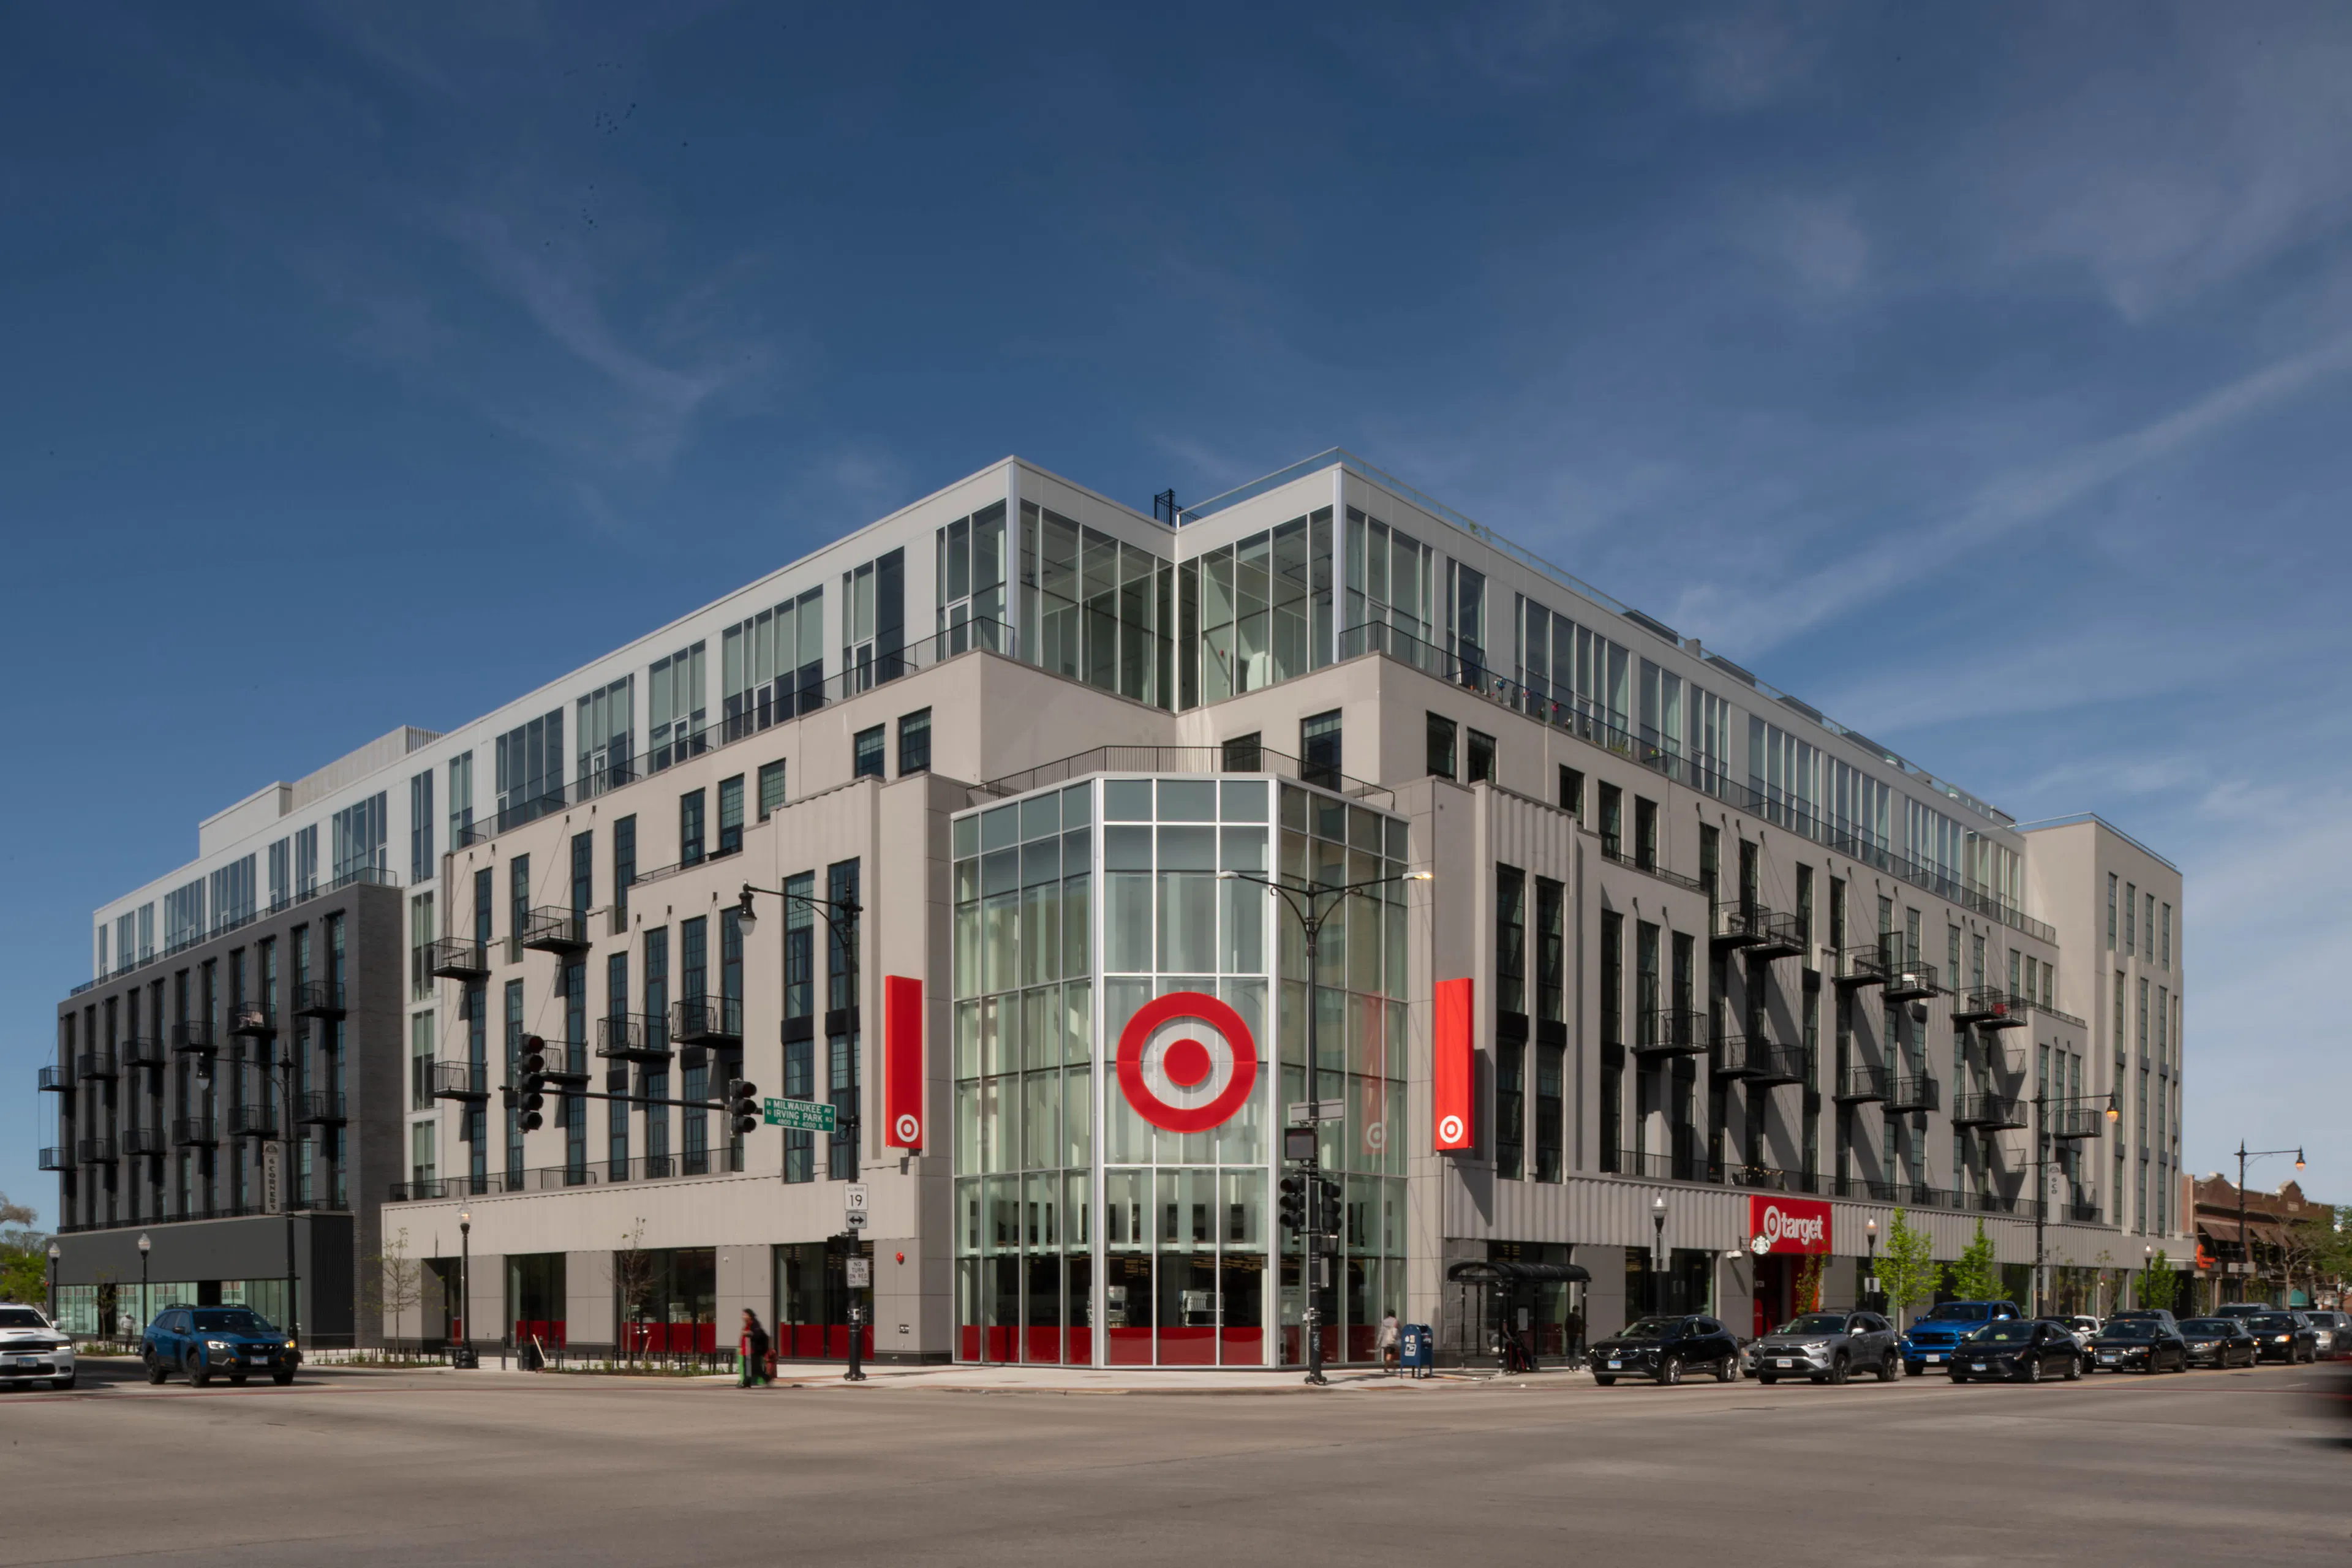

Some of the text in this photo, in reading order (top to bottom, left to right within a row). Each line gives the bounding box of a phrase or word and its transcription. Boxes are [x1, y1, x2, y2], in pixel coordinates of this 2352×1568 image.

[774, 1100, 821, 1114] MILWAUKEE
[774, 1109, 800, 1120] IRVING
[802, 1112, 823, 1123] PARK
[850, 1194, 862, 1207] 19
[1781, 1212, 1823, 1246] target
